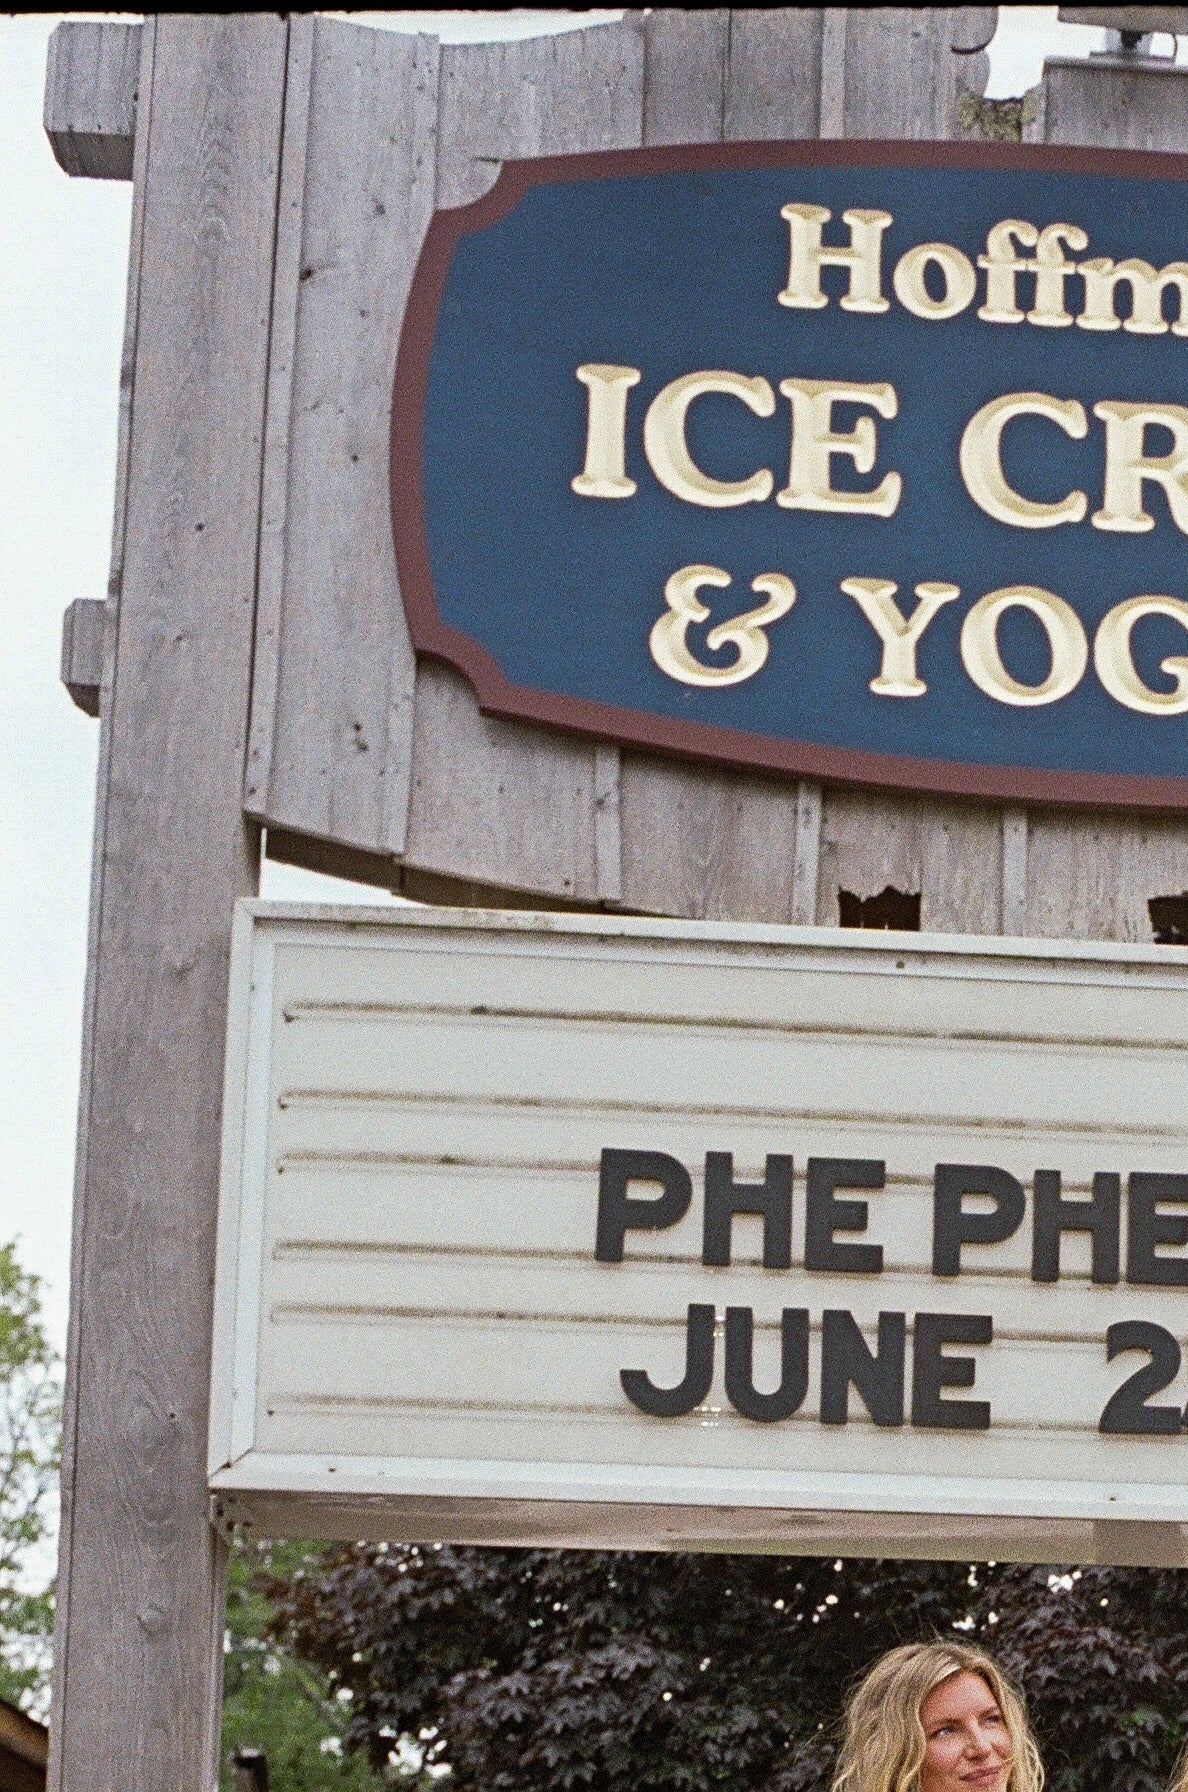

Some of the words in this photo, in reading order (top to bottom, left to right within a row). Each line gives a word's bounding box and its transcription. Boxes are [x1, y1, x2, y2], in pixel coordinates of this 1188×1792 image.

[569, 362, 903, 519] ICE
[647, 563, 797, 688] &
[592, 1147, 887, 1275] PHE
[619, 1302, 994, 1434] JUNE
